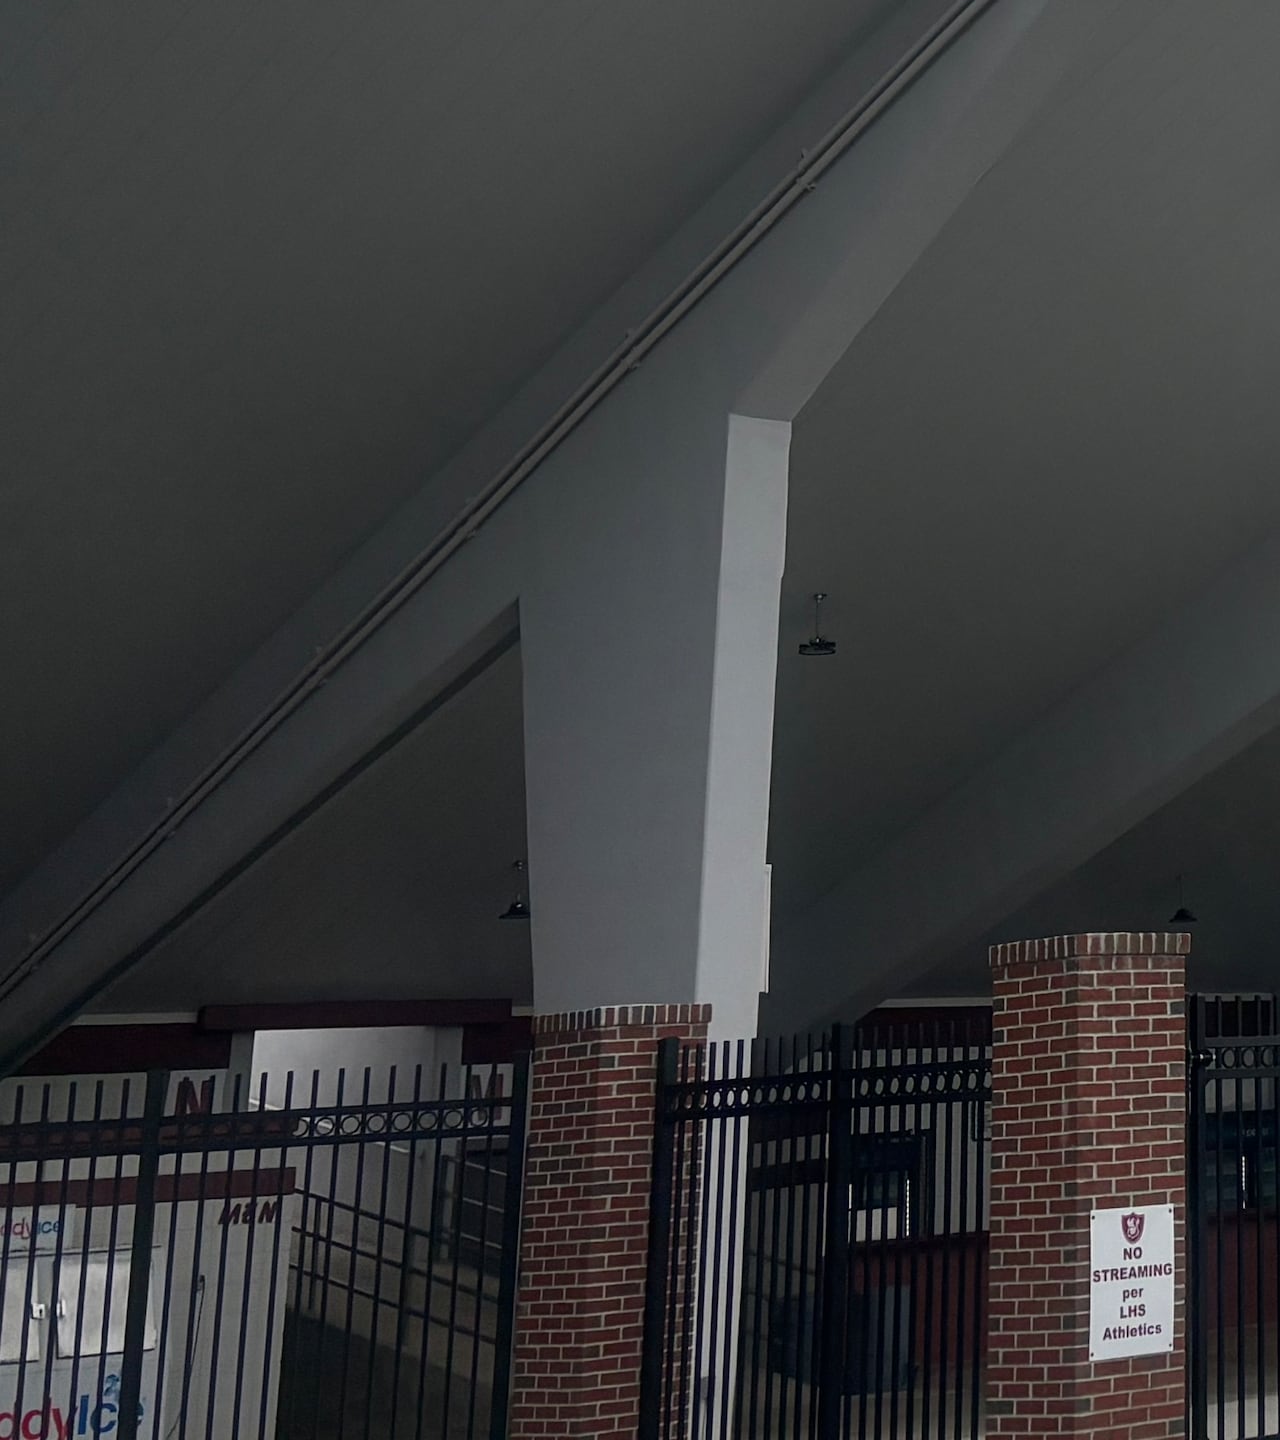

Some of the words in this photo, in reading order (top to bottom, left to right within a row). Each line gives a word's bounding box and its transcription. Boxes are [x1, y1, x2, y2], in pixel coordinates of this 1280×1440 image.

[1123, 1246, 1143, 1261] NO
[1093, 1263, 1173, 1283] STREAMING
[1122, 1287, 1144, 1302] per
[1120, 1304, 1146, 1319] LHS
[1103, 1323, 1162, 1341] Athletics
